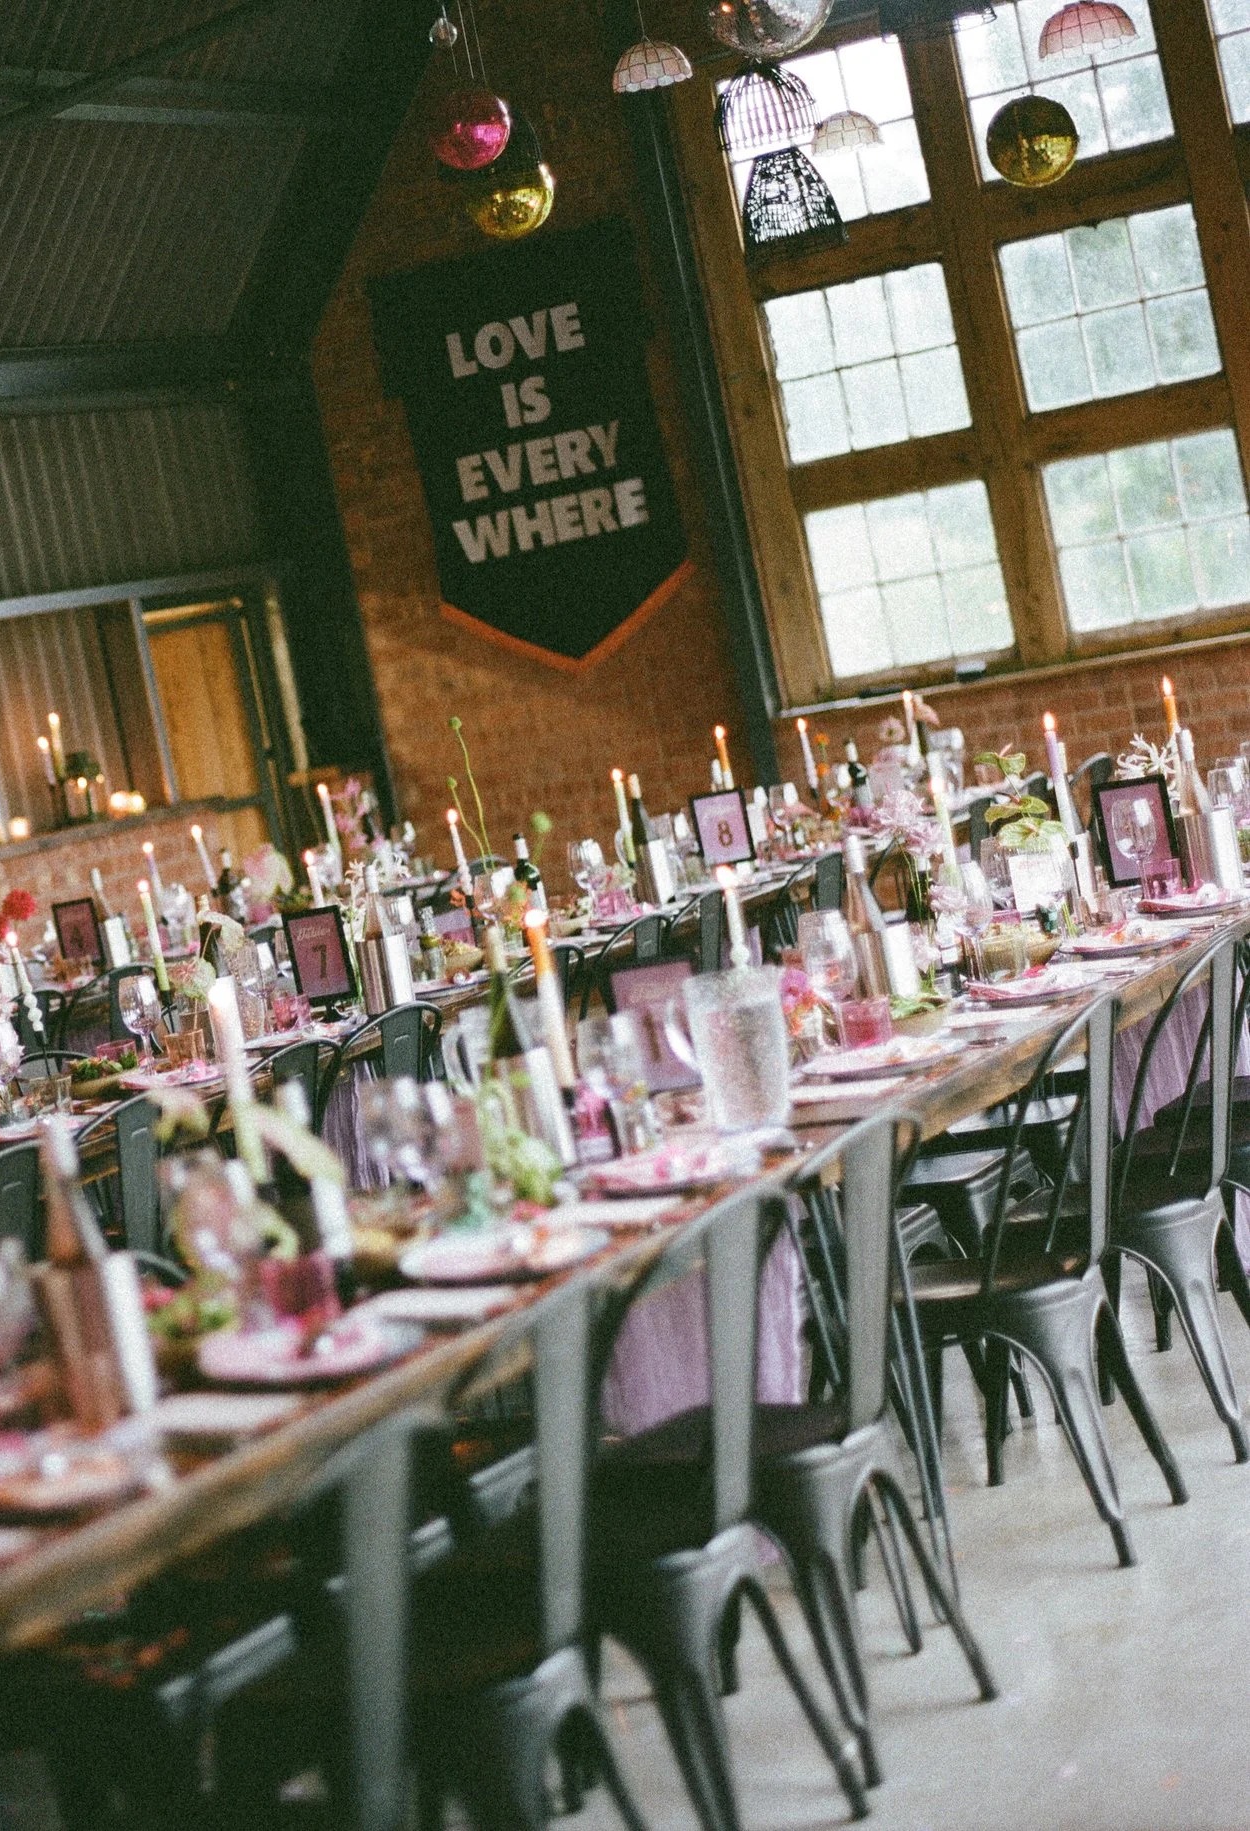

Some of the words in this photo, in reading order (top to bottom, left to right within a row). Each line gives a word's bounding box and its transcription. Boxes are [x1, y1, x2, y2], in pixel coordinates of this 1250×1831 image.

[447, 303, 585, 378] LOVE
[501, 377, 551, 428] IS
[456, 421, 619, 502] EVERY
[453, 478, 649, 564] WHERE
[718, 817, 734, 849] 8
[312, 943, 328, 980] 7
